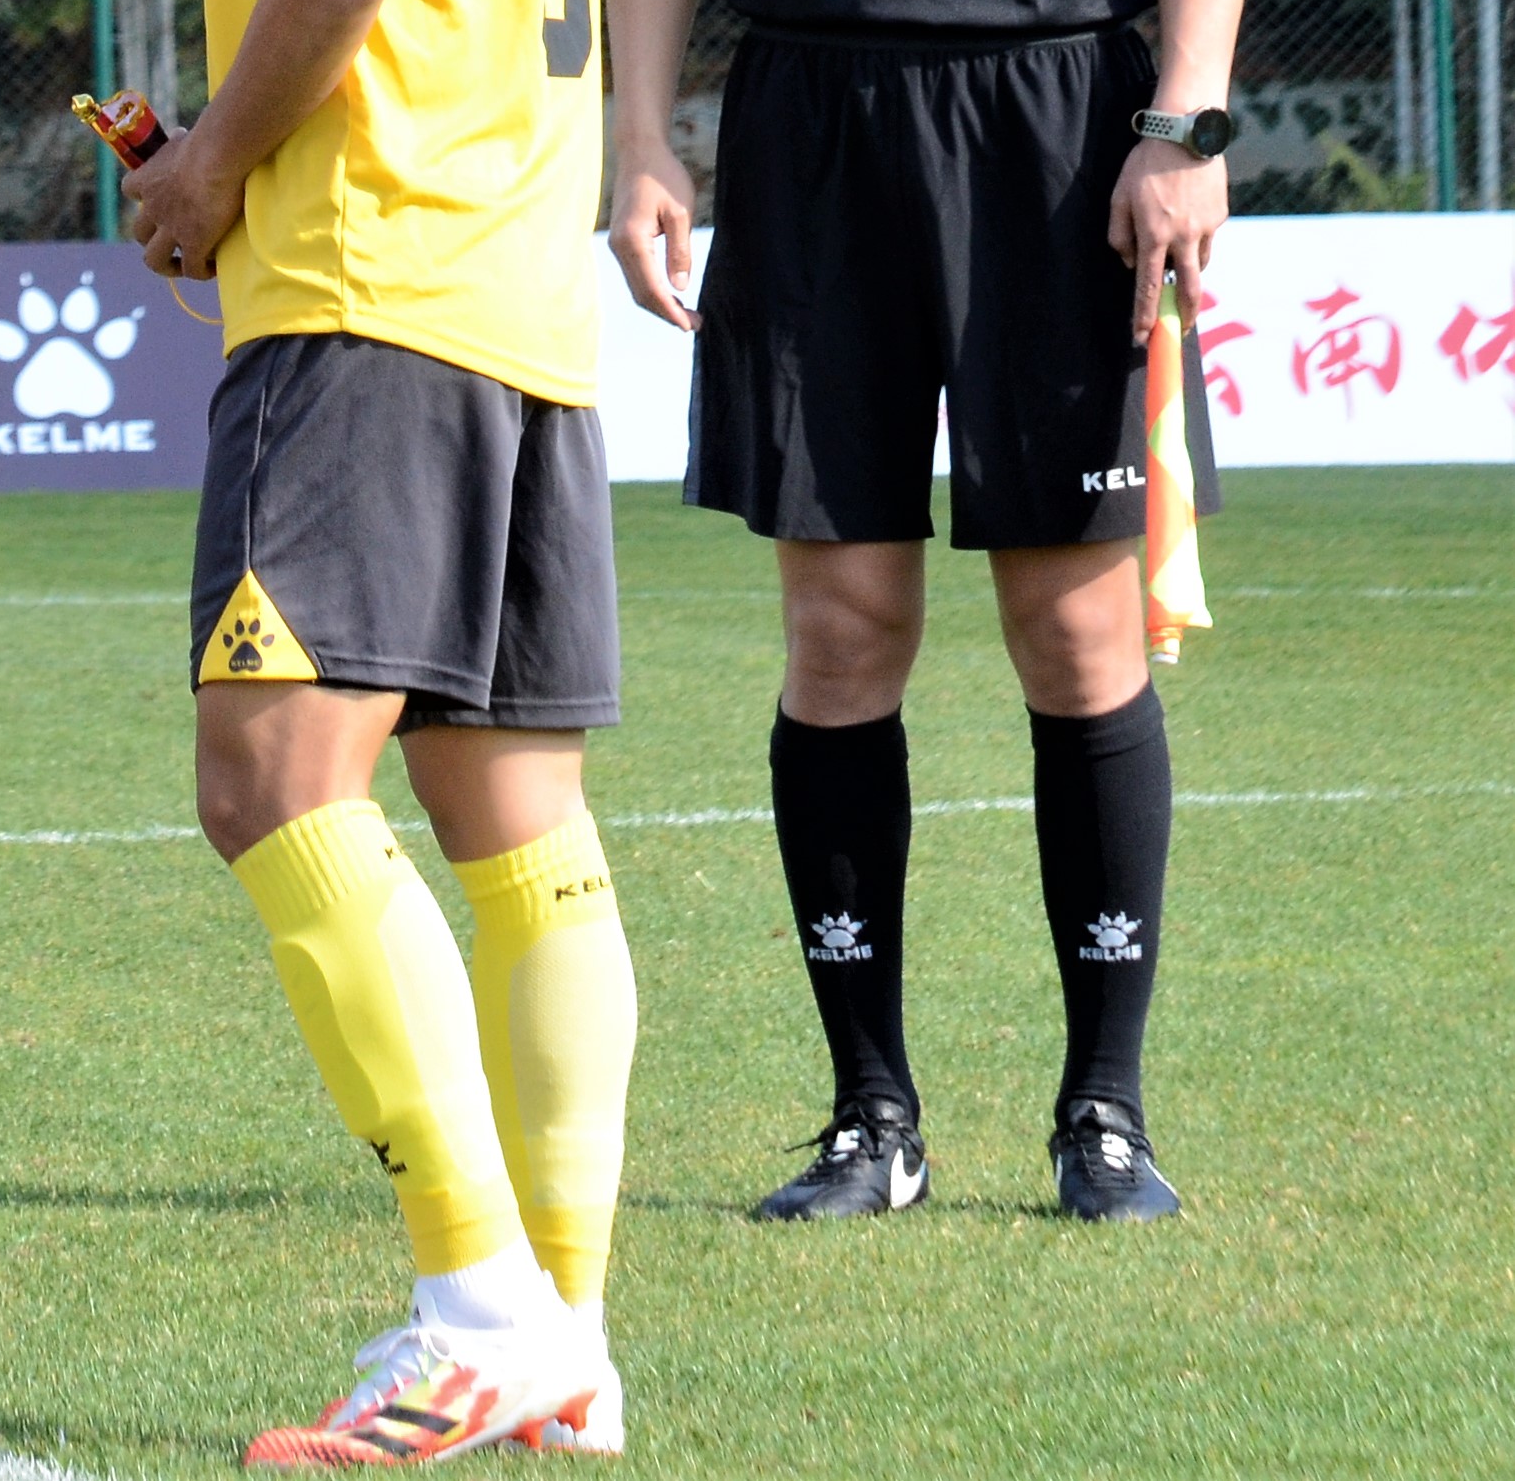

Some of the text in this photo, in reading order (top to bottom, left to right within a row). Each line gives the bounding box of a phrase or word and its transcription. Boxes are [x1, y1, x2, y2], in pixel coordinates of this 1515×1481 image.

[1082, 465, 1147, 494] KEL
[808, 943, 874, 964] KELME
[1078, 942, 1143, 963] KELME
